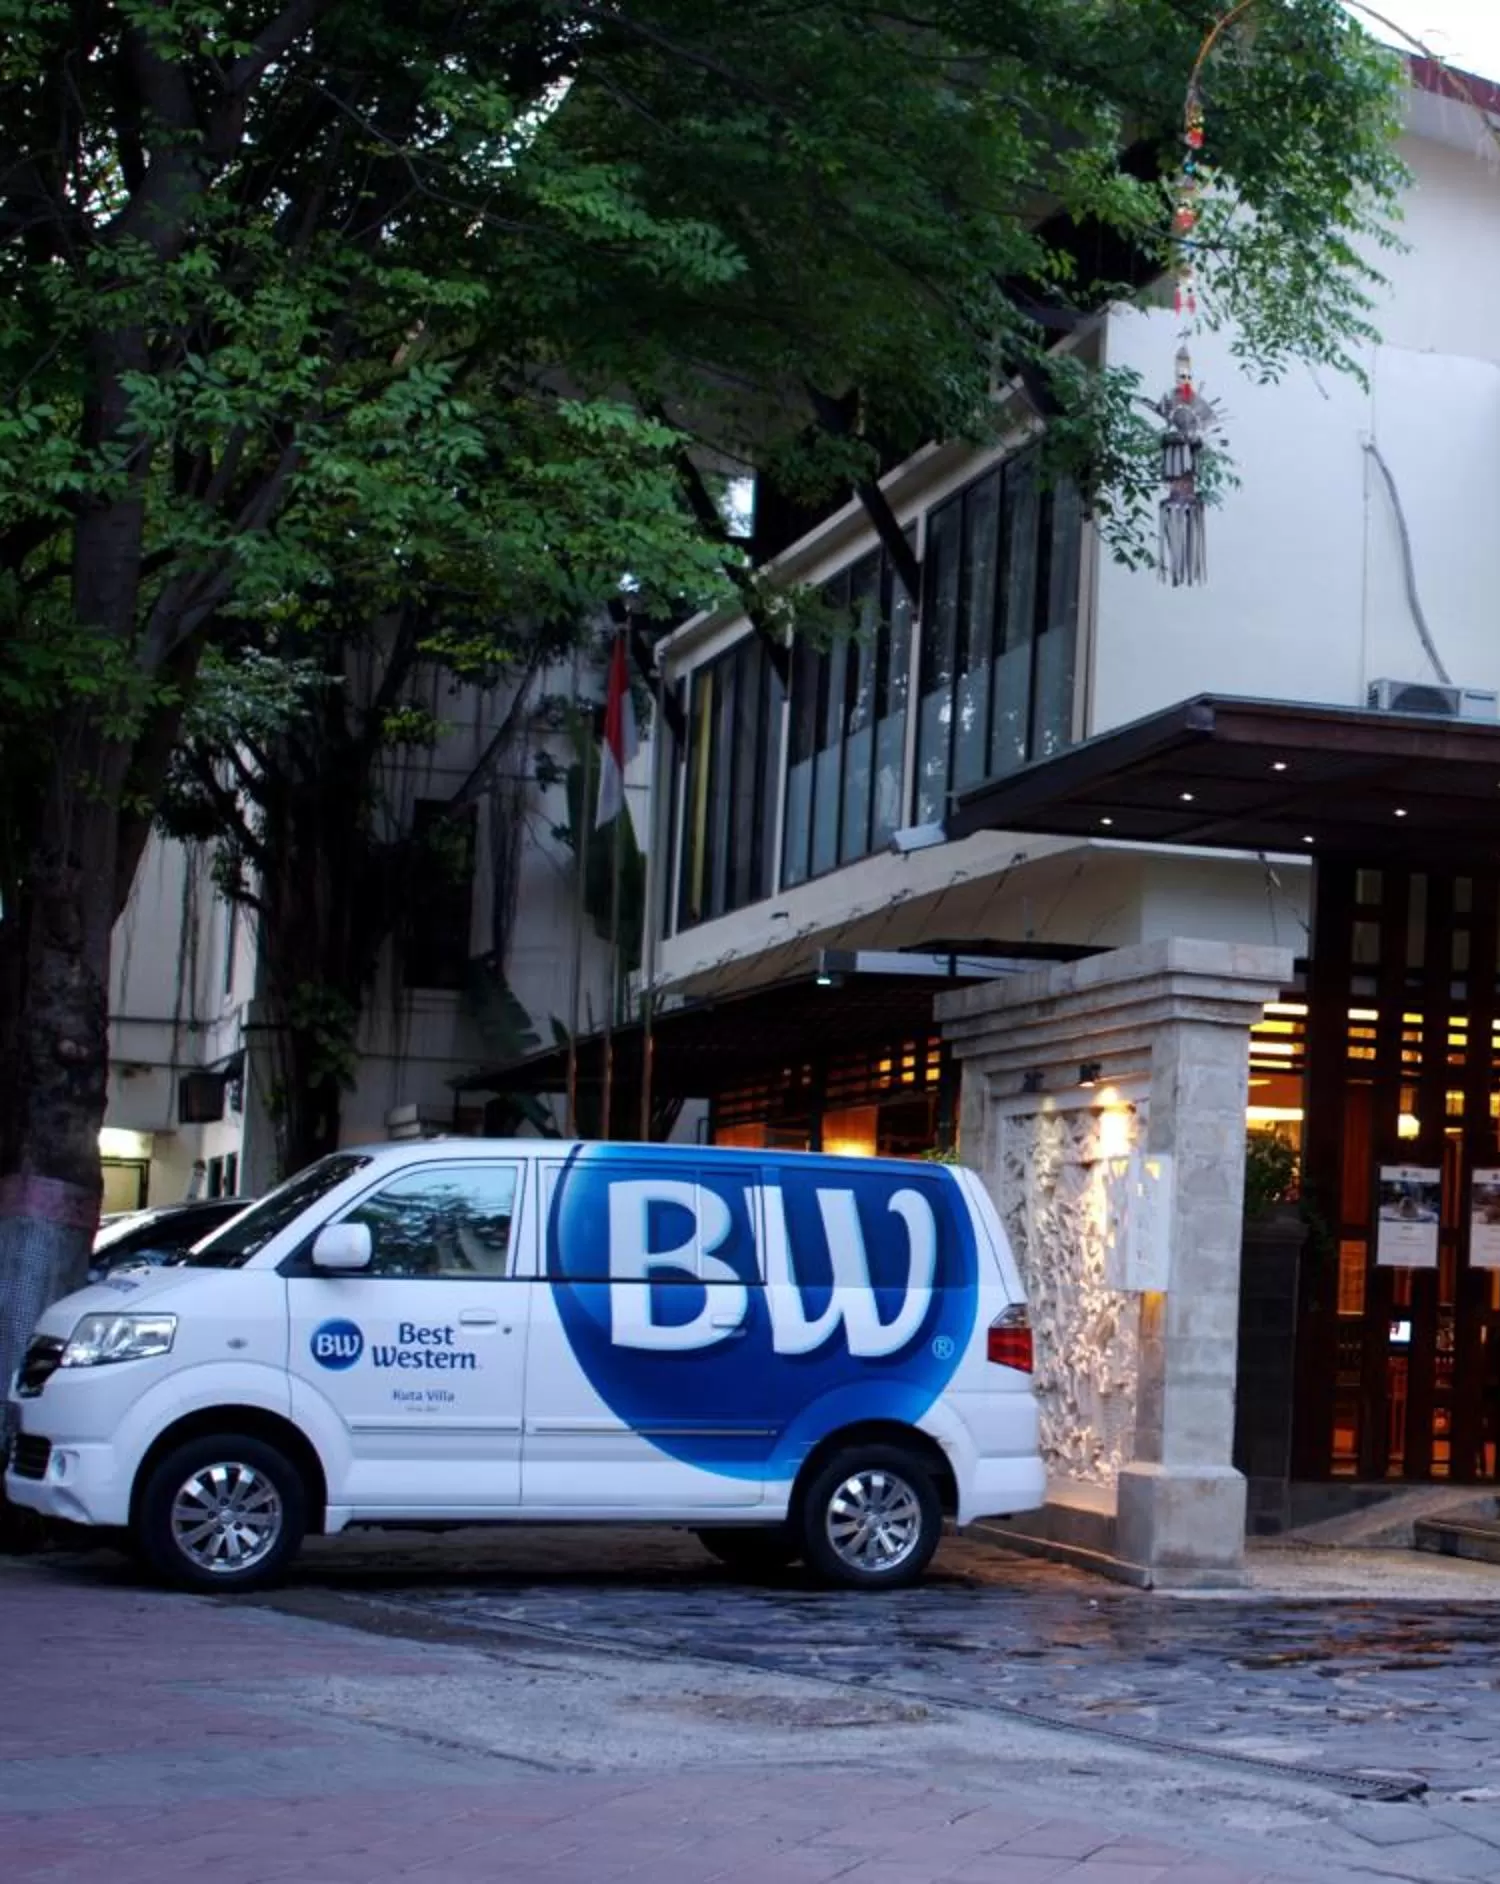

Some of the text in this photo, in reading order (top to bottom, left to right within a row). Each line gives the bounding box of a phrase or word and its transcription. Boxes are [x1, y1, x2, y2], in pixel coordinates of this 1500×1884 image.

[607, 1179, 938, 1358] BW
[317, 1332, 361, 1358] BW
[398, 1321, 456, 1346] Best
[371, 1345, 477, 1370] Western
[392, 1388, 456, 1403] Kuta Villa
